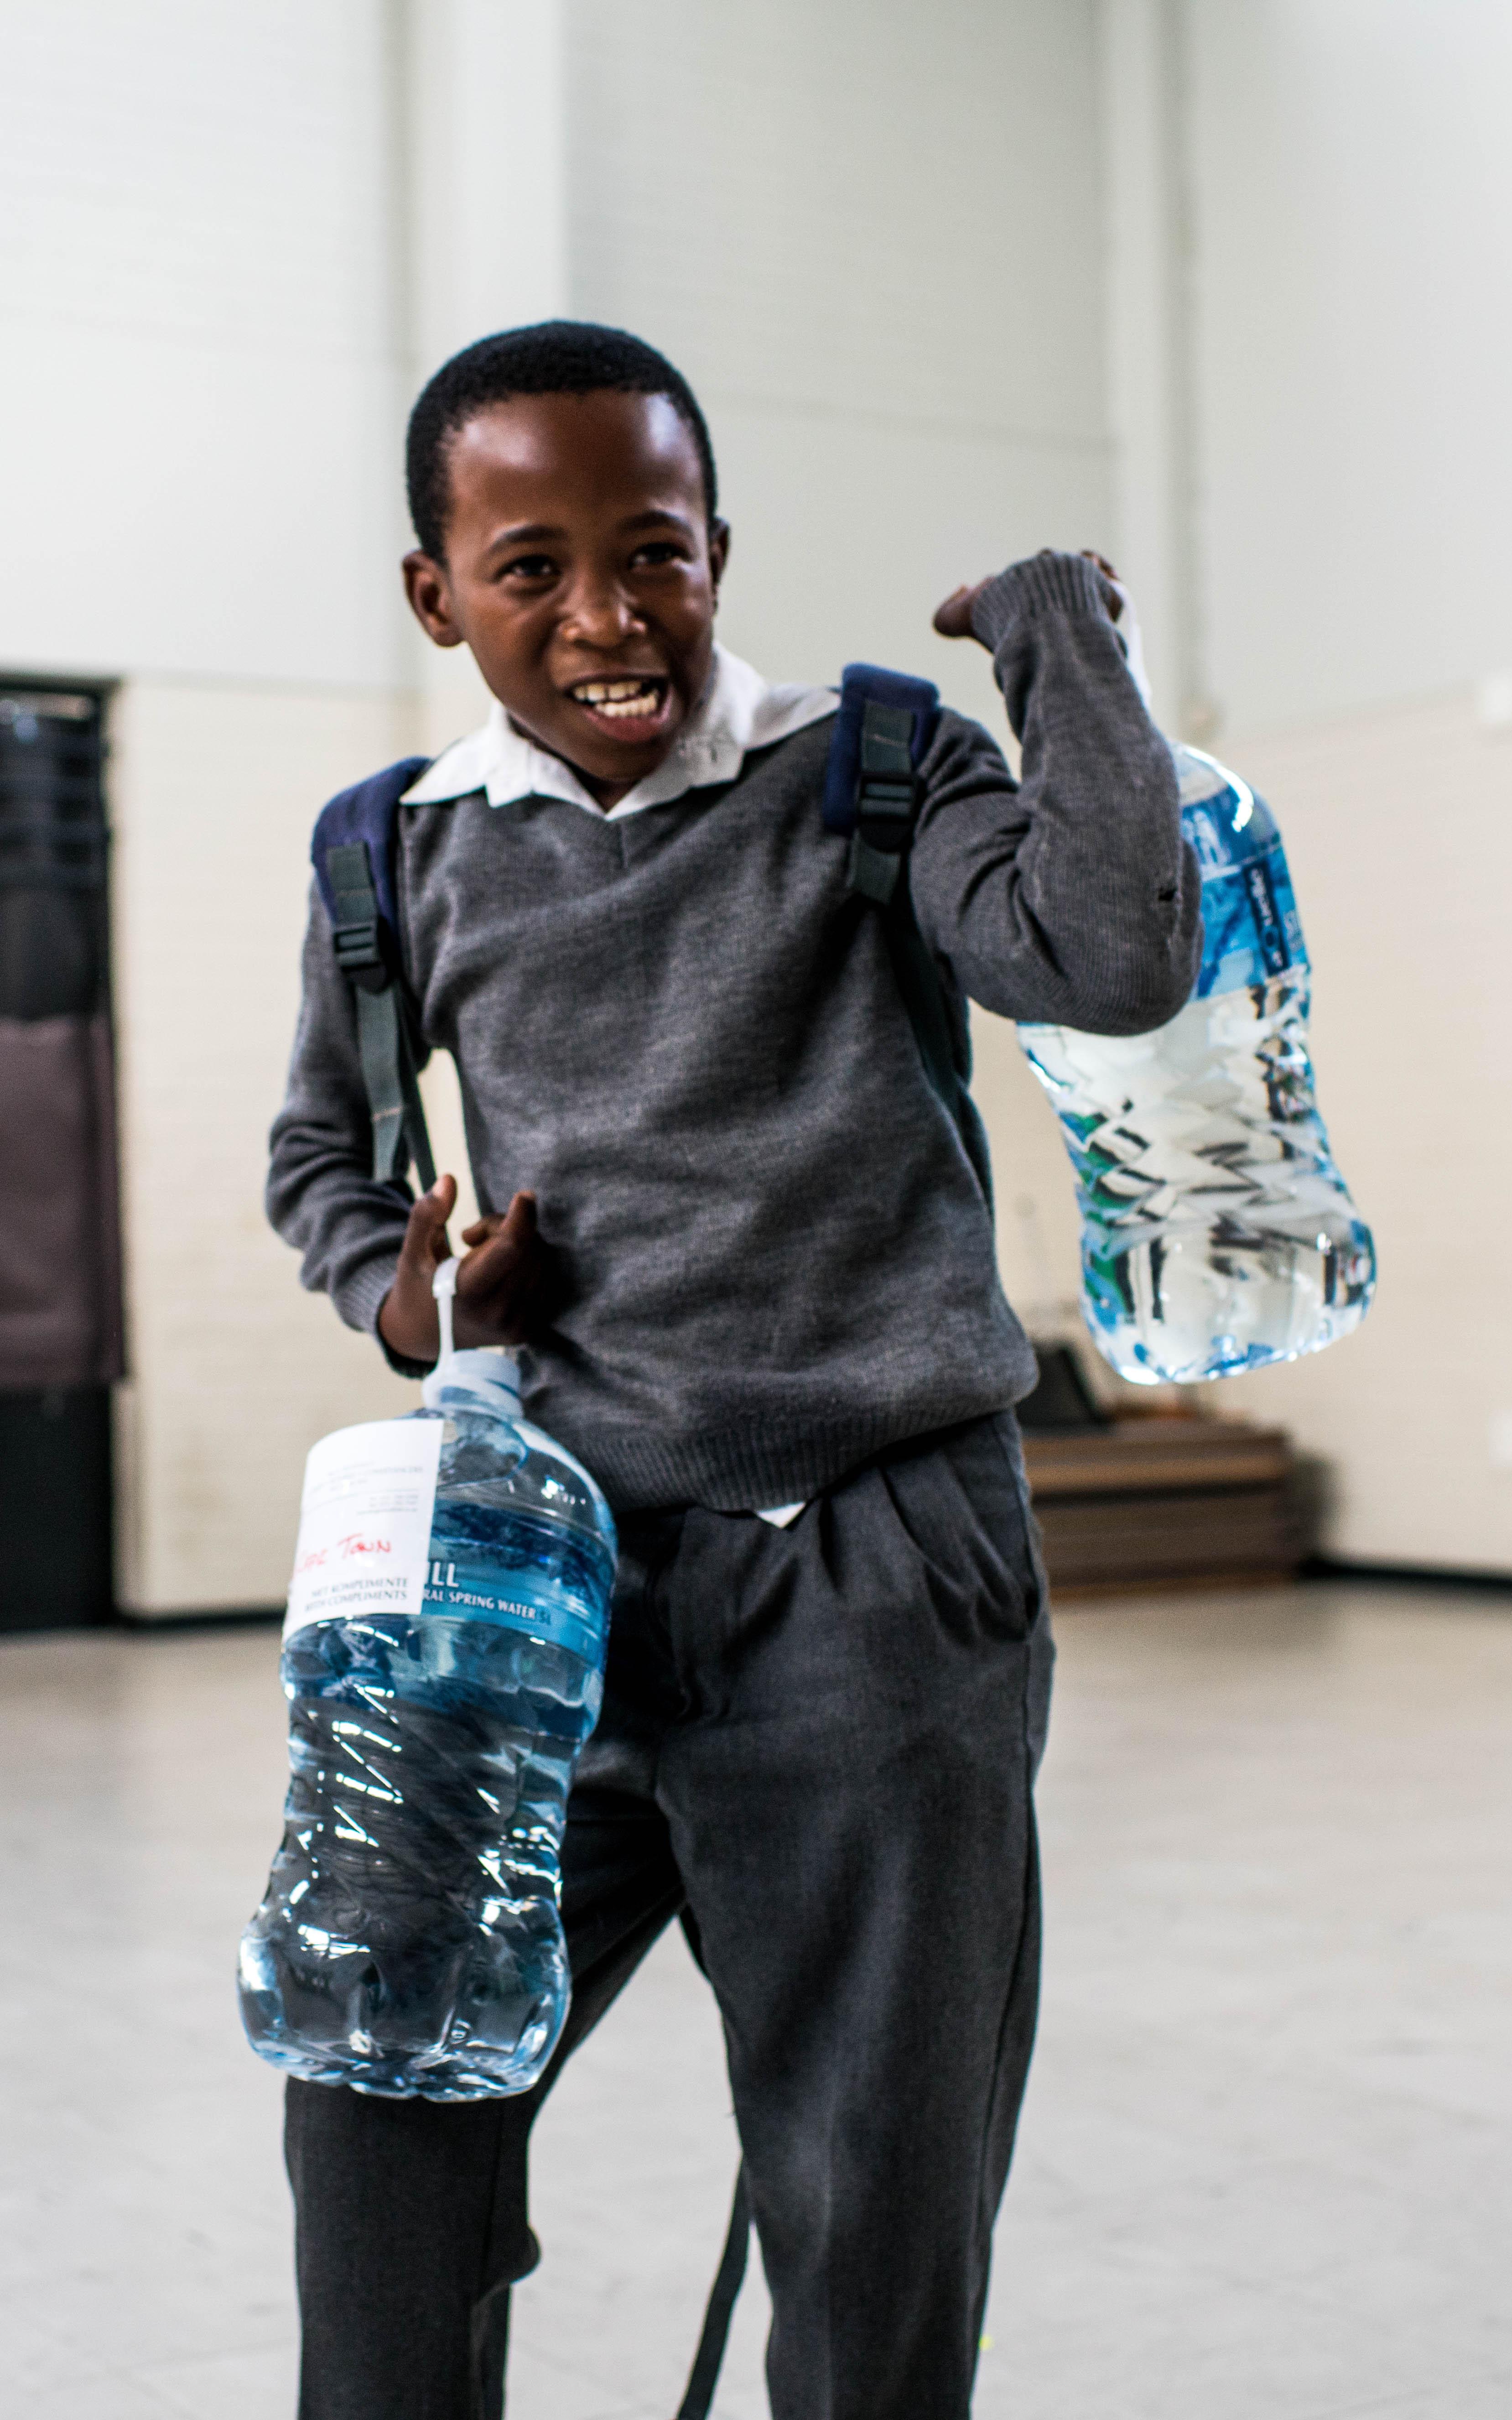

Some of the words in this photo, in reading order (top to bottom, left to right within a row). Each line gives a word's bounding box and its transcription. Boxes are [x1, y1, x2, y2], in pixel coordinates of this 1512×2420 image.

[332, 1577, 408, 1594] KOMPLIMENTE
[328, 1590, 407, 1606] COMPLIMENTS
[449, 1591, 494, 1610] SPRING
[498, 1599, 536, 1619] WATER
